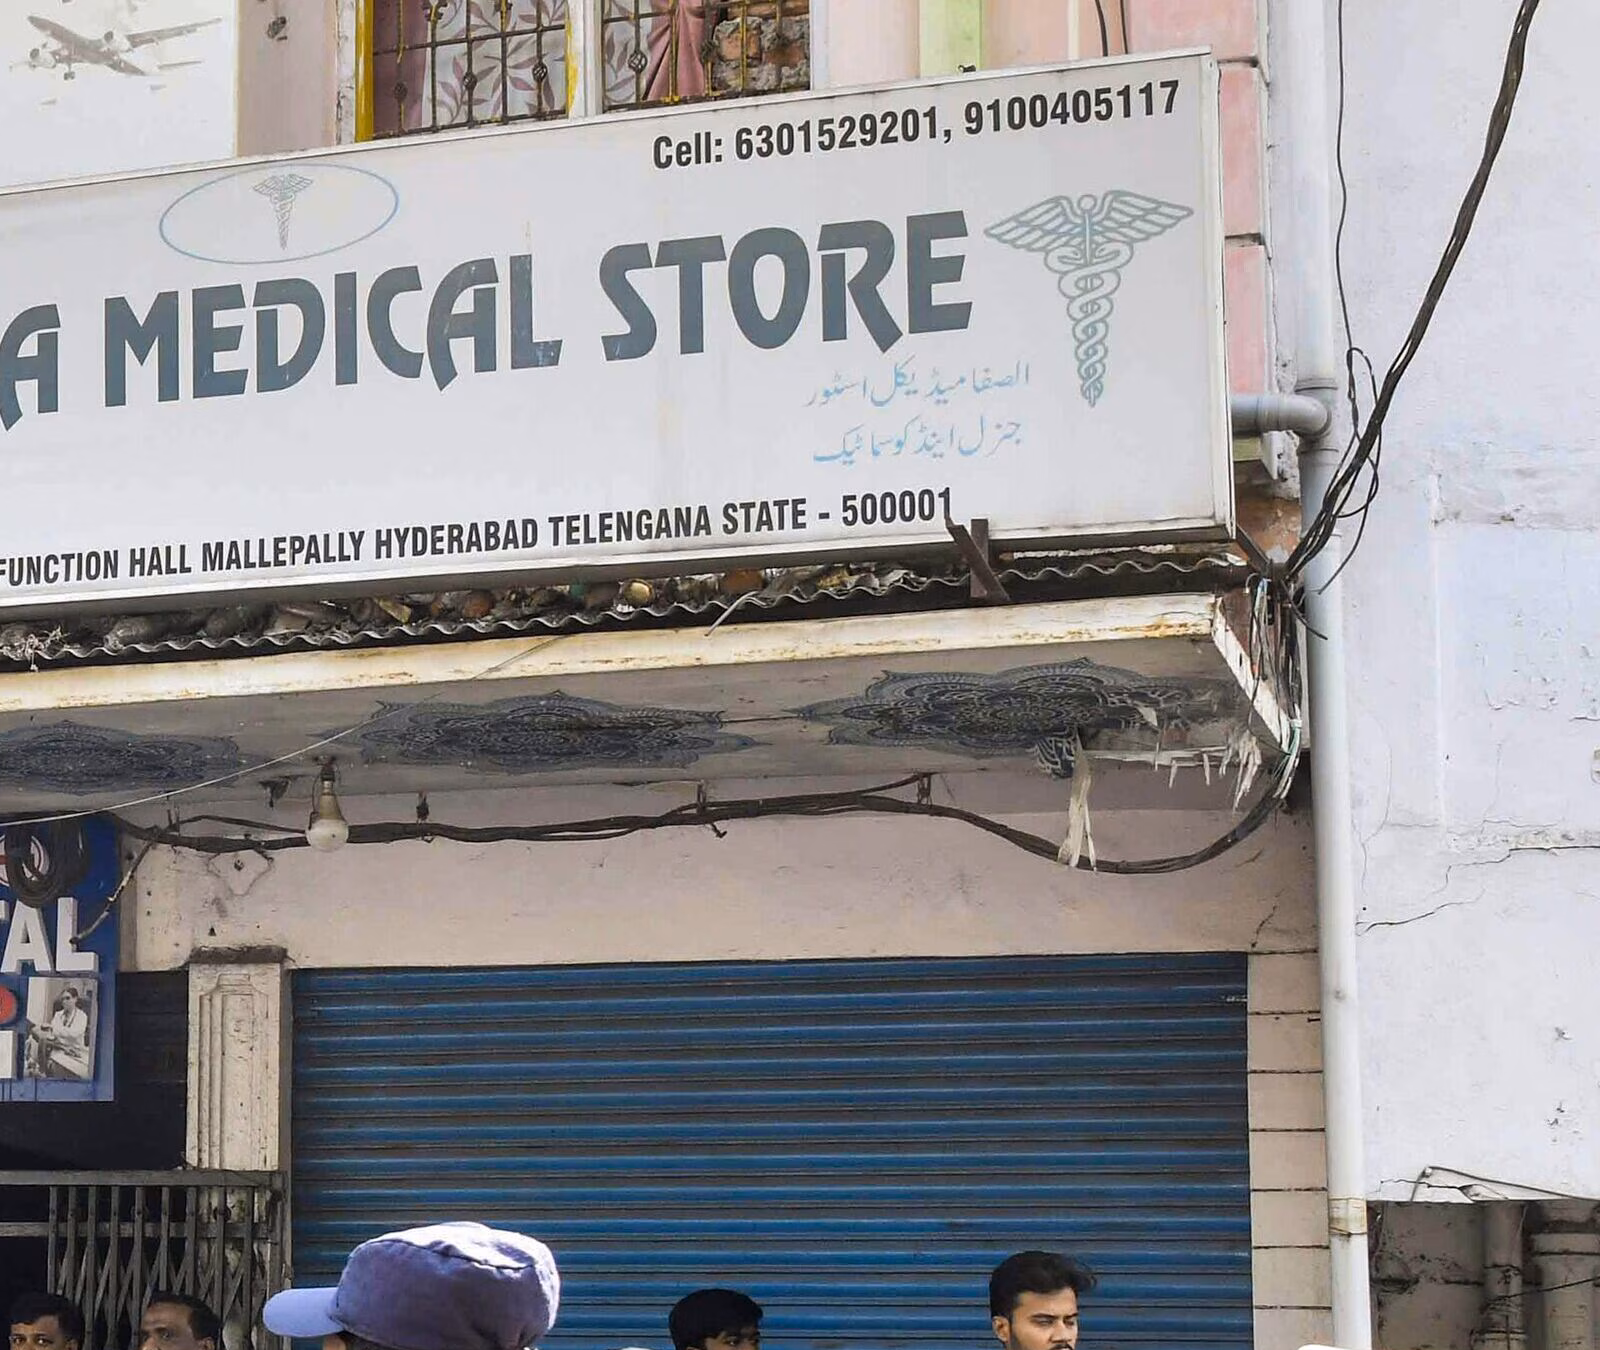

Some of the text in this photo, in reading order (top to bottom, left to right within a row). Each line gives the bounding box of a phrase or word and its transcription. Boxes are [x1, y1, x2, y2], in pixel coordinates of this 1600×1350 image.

[652, 79, 1180, 170] Cell: 6301529201, 9100405117
[102, 253, 561, 408] MEDICAL
[597, 210, 973, 362] STORE
[128, 542, 193, 578] HALL
[202, 526, 365, 573] MALLEPALLY
[374, 516, 539, 561] HYDERABAD
[550, 504, 713, 548] TELENGANA
[722, 496, 808, 535] STATE
[841, 486, 953, 526] 500001
